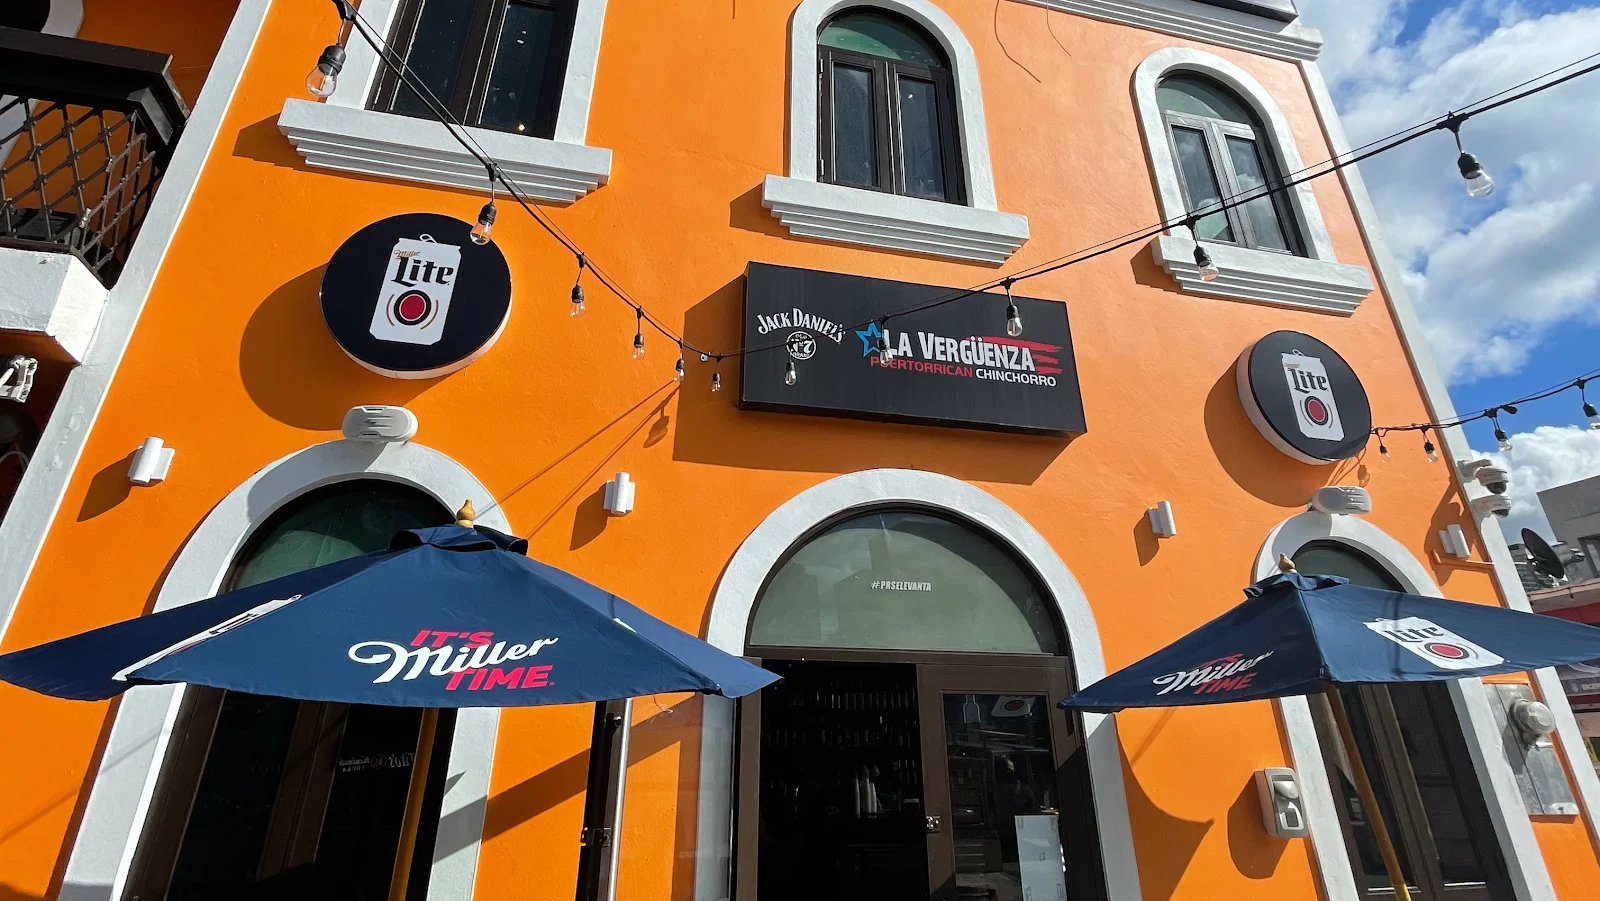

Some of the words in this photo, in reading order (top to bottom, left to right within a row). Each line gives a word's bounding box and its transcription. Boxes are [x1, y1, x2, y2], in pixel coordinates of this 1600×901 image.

[391, 257, 454, 288] Lite
[757, 312, 792, 334] JACK
[883, 328, 913, 357] LA
[918, 331, 1036, 371] VERGÜENZA
[975, 368, 1057, 387] CHINCHORRO
[1288, 368, 1328, 394] Lite
[410, 629, 495, 649] IT'S
[348, 637, 559, 684] Miller
[1152, 650, 1275, 696] Miller
